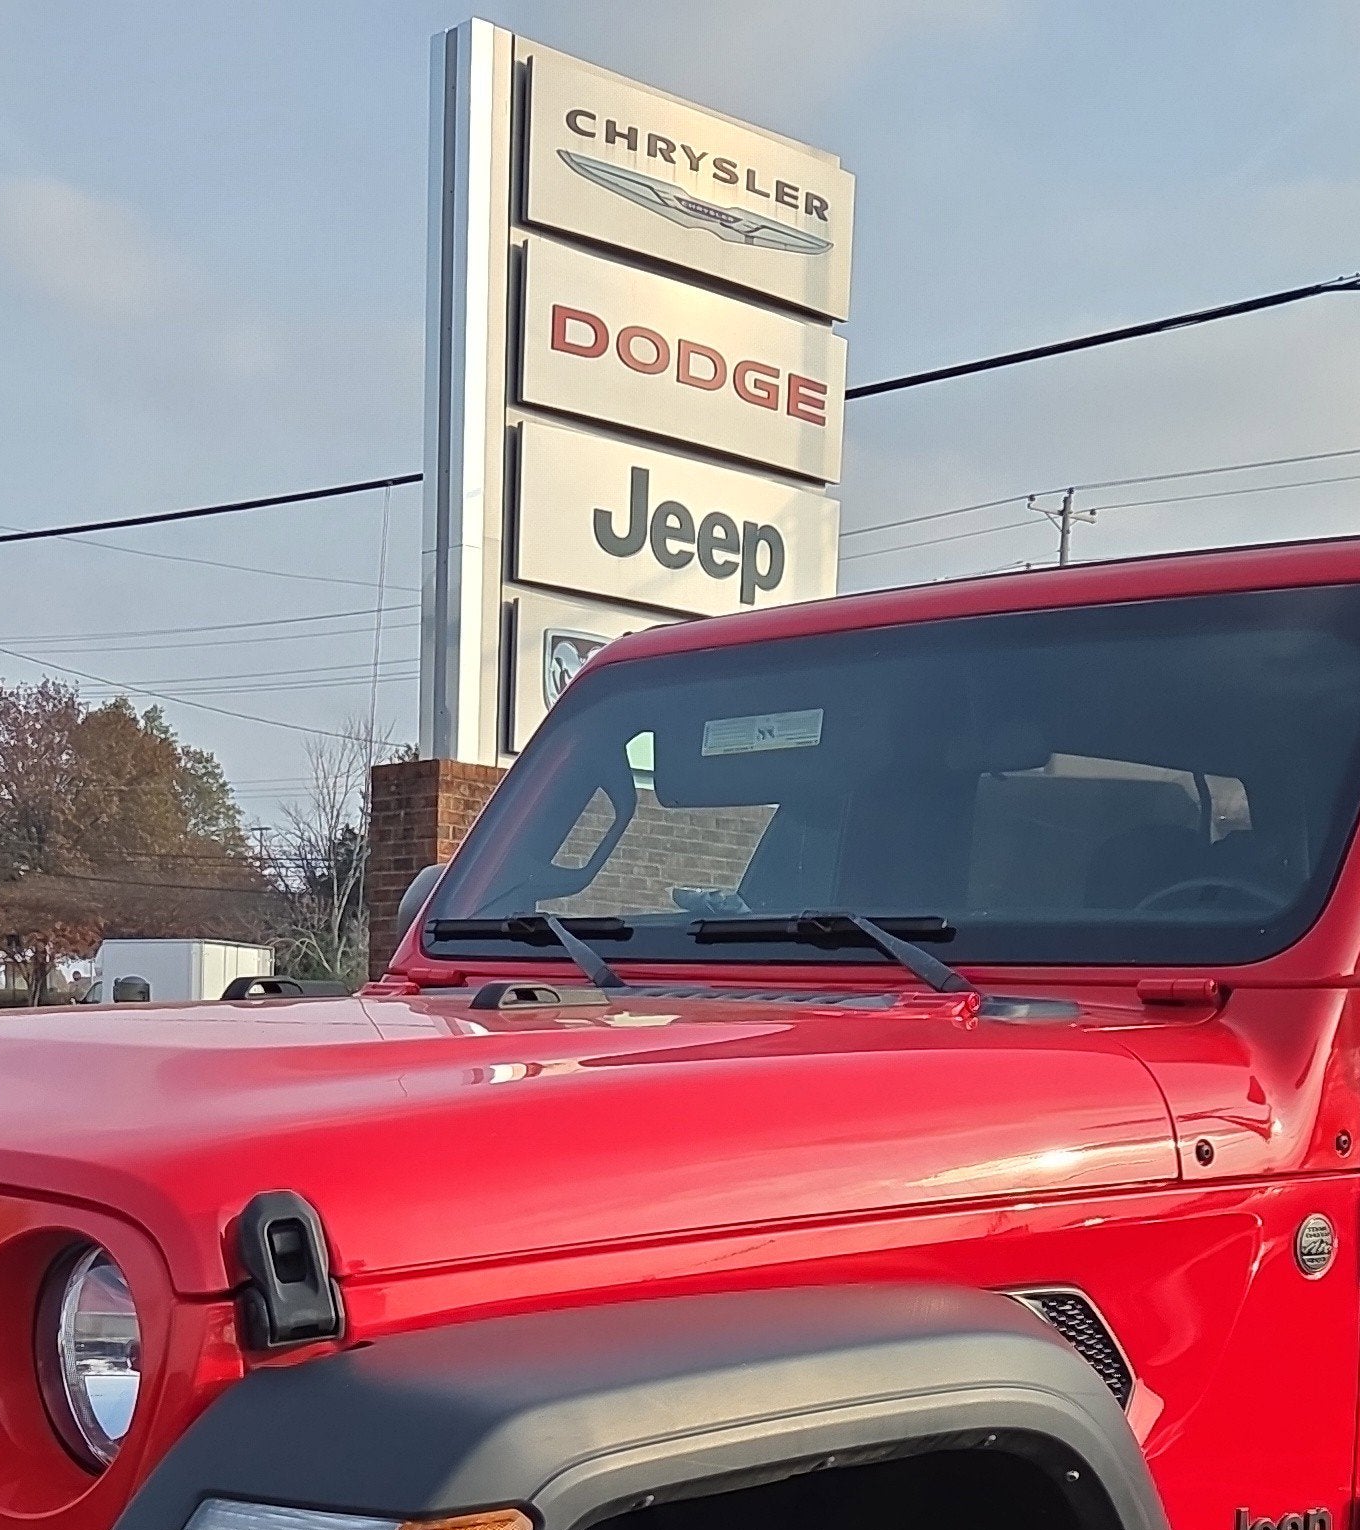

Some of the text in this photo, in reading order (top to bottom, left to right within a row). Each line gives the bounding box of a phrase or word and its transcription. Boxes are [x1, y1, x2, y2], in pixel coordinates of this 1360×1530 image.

[565, 108, 830, 222] CHRYSLER
[551, 303, 827, 427] DODGE
[593, 466, 785, 605] Jeep
